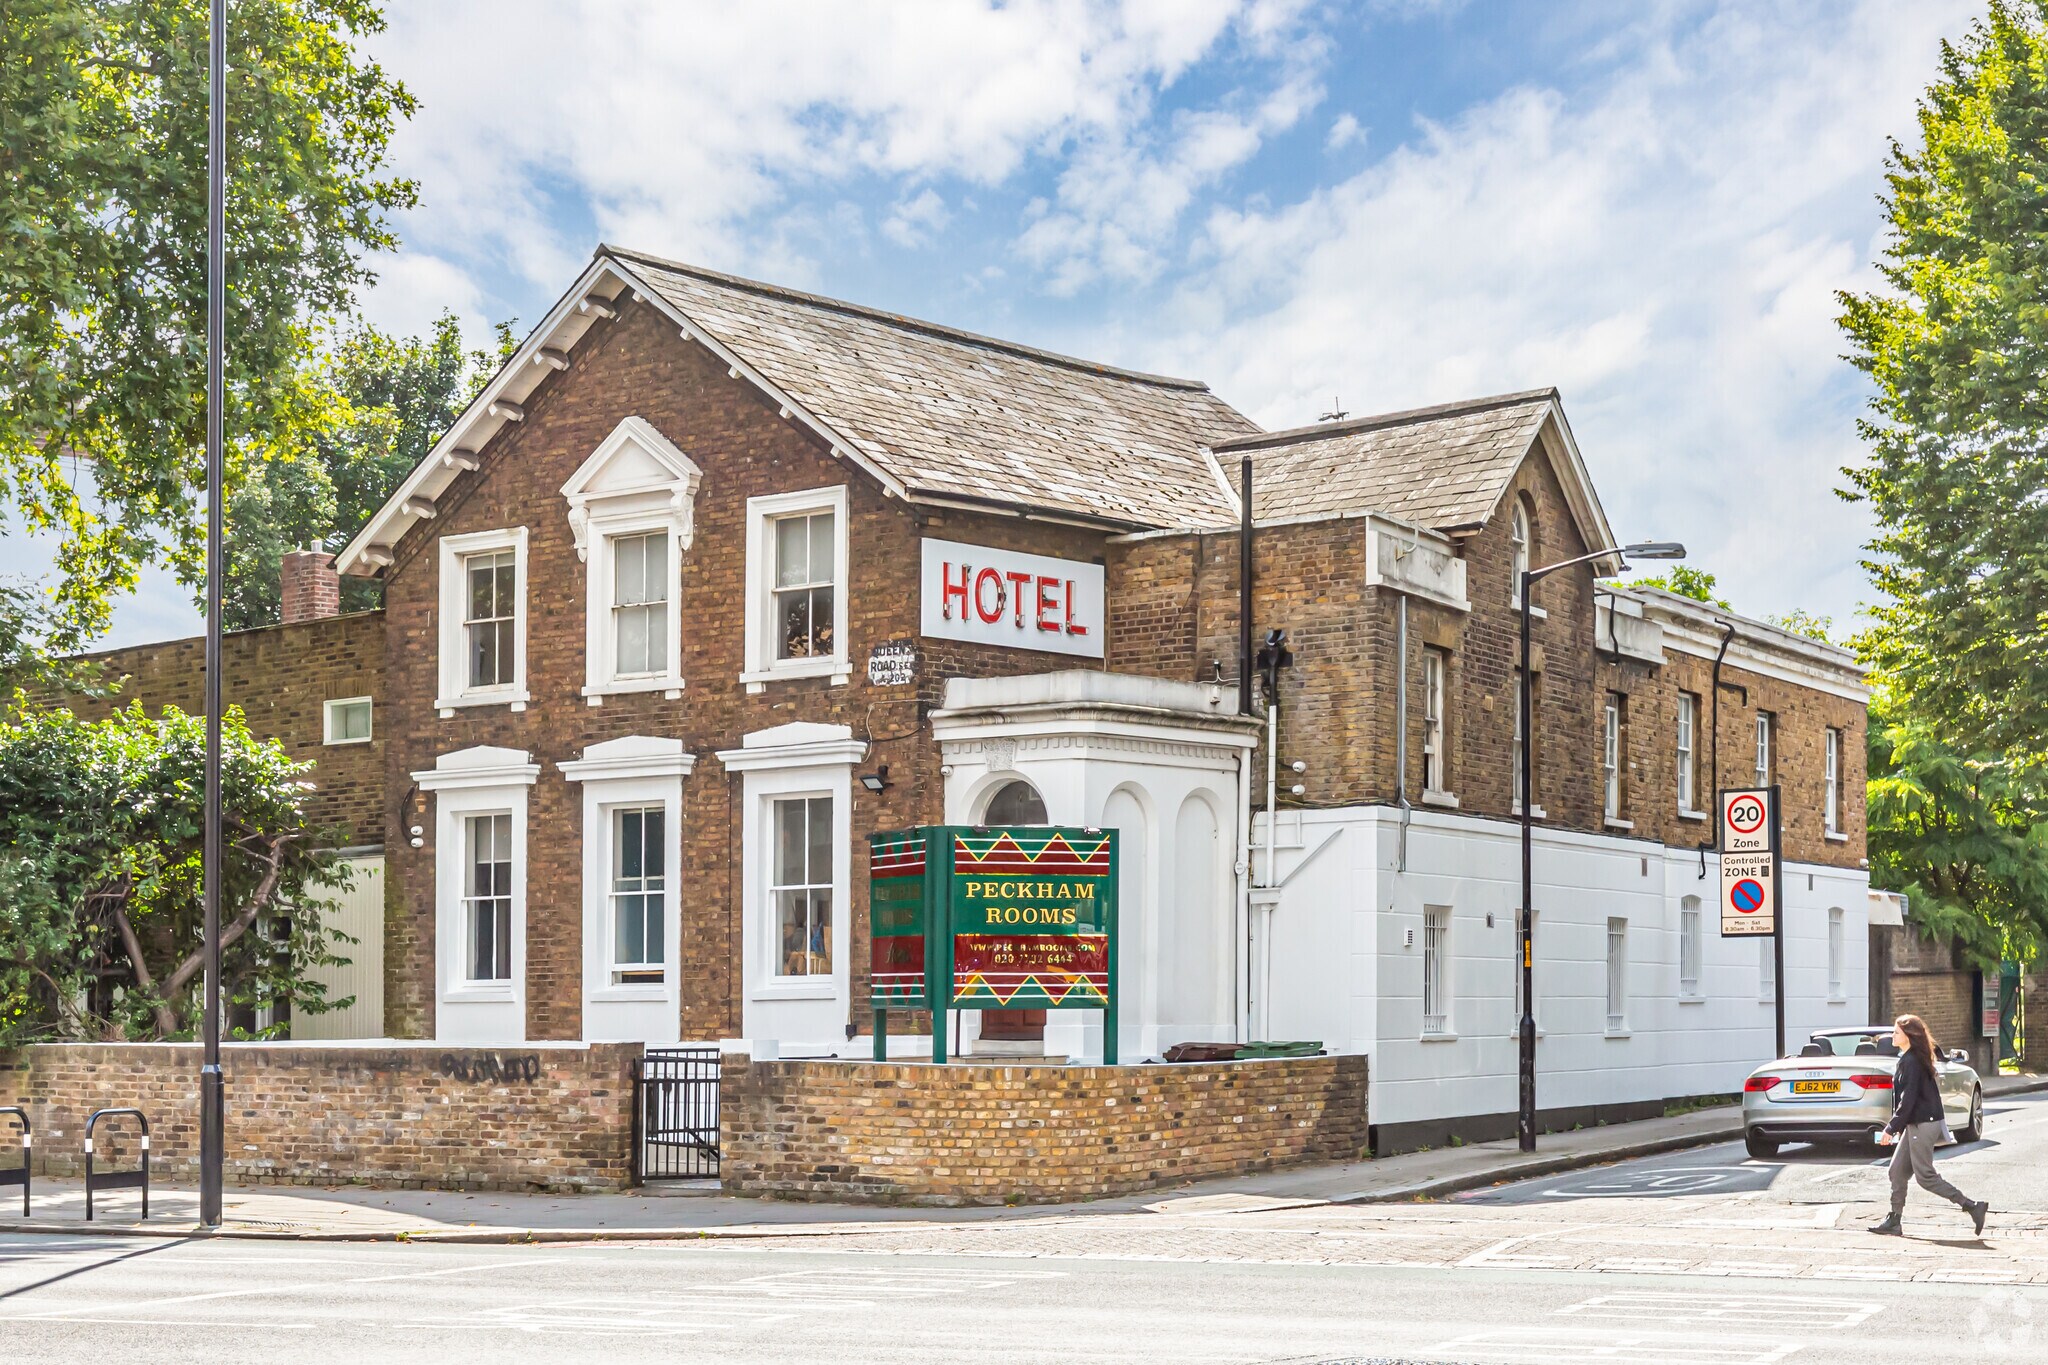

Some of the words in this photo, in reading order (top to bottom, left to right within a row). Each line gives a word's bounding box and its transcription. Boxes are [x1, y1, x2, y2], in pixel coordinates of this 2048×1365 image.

[942, 561, 1090, 636] HOTEL
[1733, 806, 1759, 822] 20
[1733, 838, 1760, 848] Zone
[1724, 856, 1771, 865] Controlled
[1725, 867, 1757, 877] ZONE
[966, 882, 1095, 899] PECKHAM
[986, 907, 1076, 924] ROOMS
[970, 943, 1096, 952] WWW.PECHMROOMS.COM
[994, 954, 1015, 964] 020
[1795, 1082, 1819, 1091] EJ62
[1822, 1082, 1839, 1090] YRK
